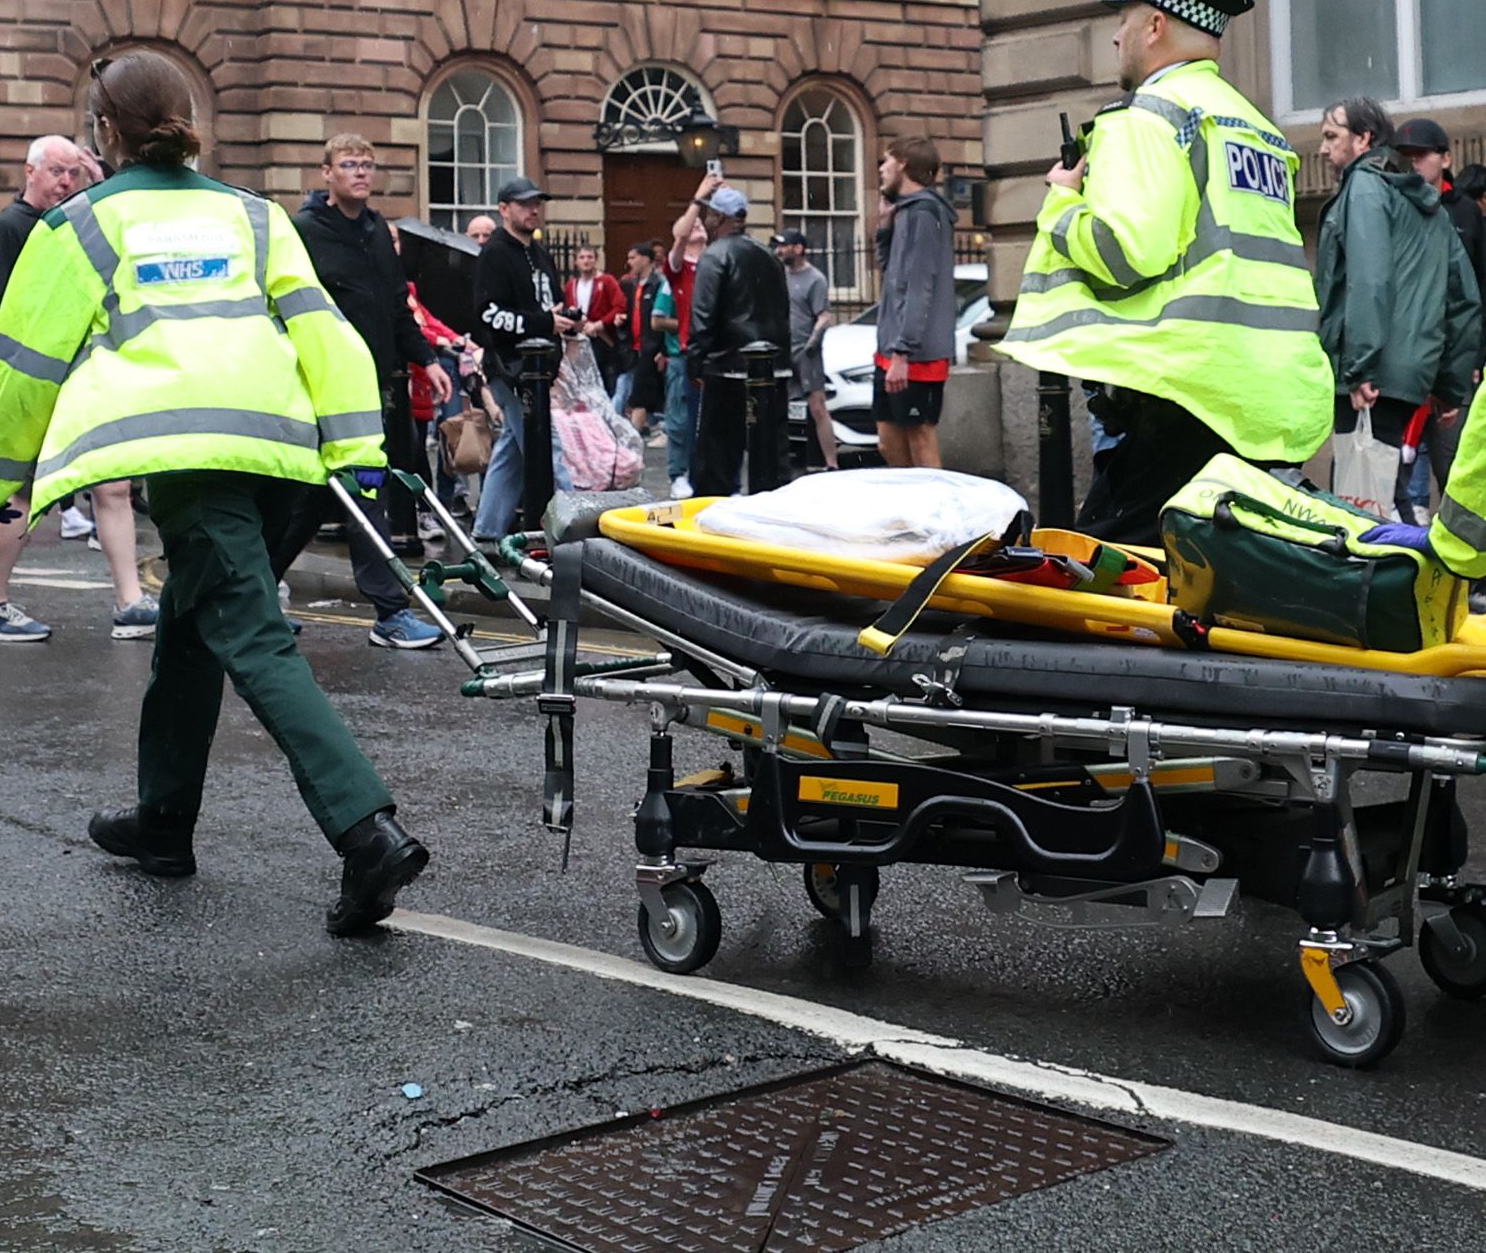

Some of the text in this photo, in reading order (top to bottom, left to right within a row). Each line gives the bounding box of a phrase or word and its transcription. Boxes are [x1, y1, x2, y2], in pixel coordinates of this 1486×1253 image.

[163, 260, 204, 280] NHS
[481, 302, 525, 335] 1892
[822, 790, 880, 804] PEGASUS
